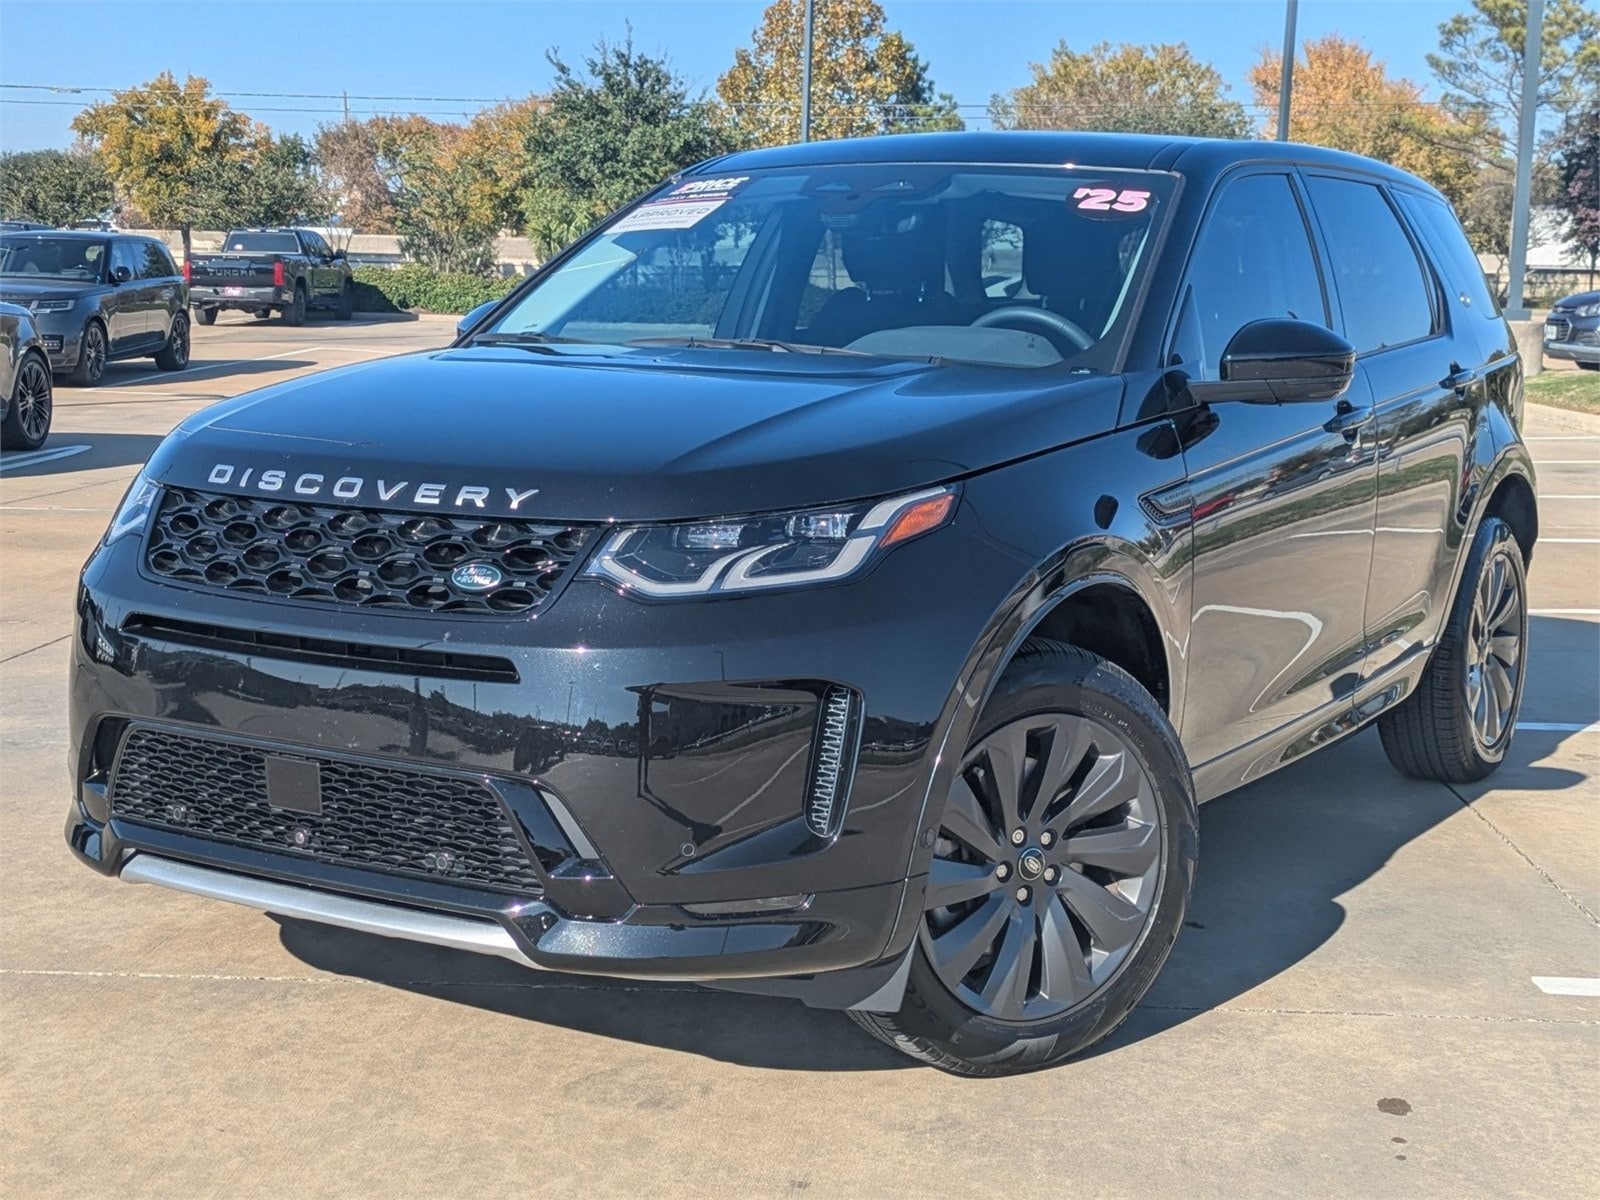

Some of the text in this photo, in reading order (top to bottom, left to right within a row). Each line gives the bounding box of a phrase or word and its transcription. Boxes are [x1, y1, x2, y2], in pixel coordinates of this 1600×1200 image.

[1073, 187, 1151, 212] '25
[630, 207, 711, 220] APPROVED
[206, 268, 257, 277] TUNDRA
[207, 463, 540, 510] DISCOVERY
